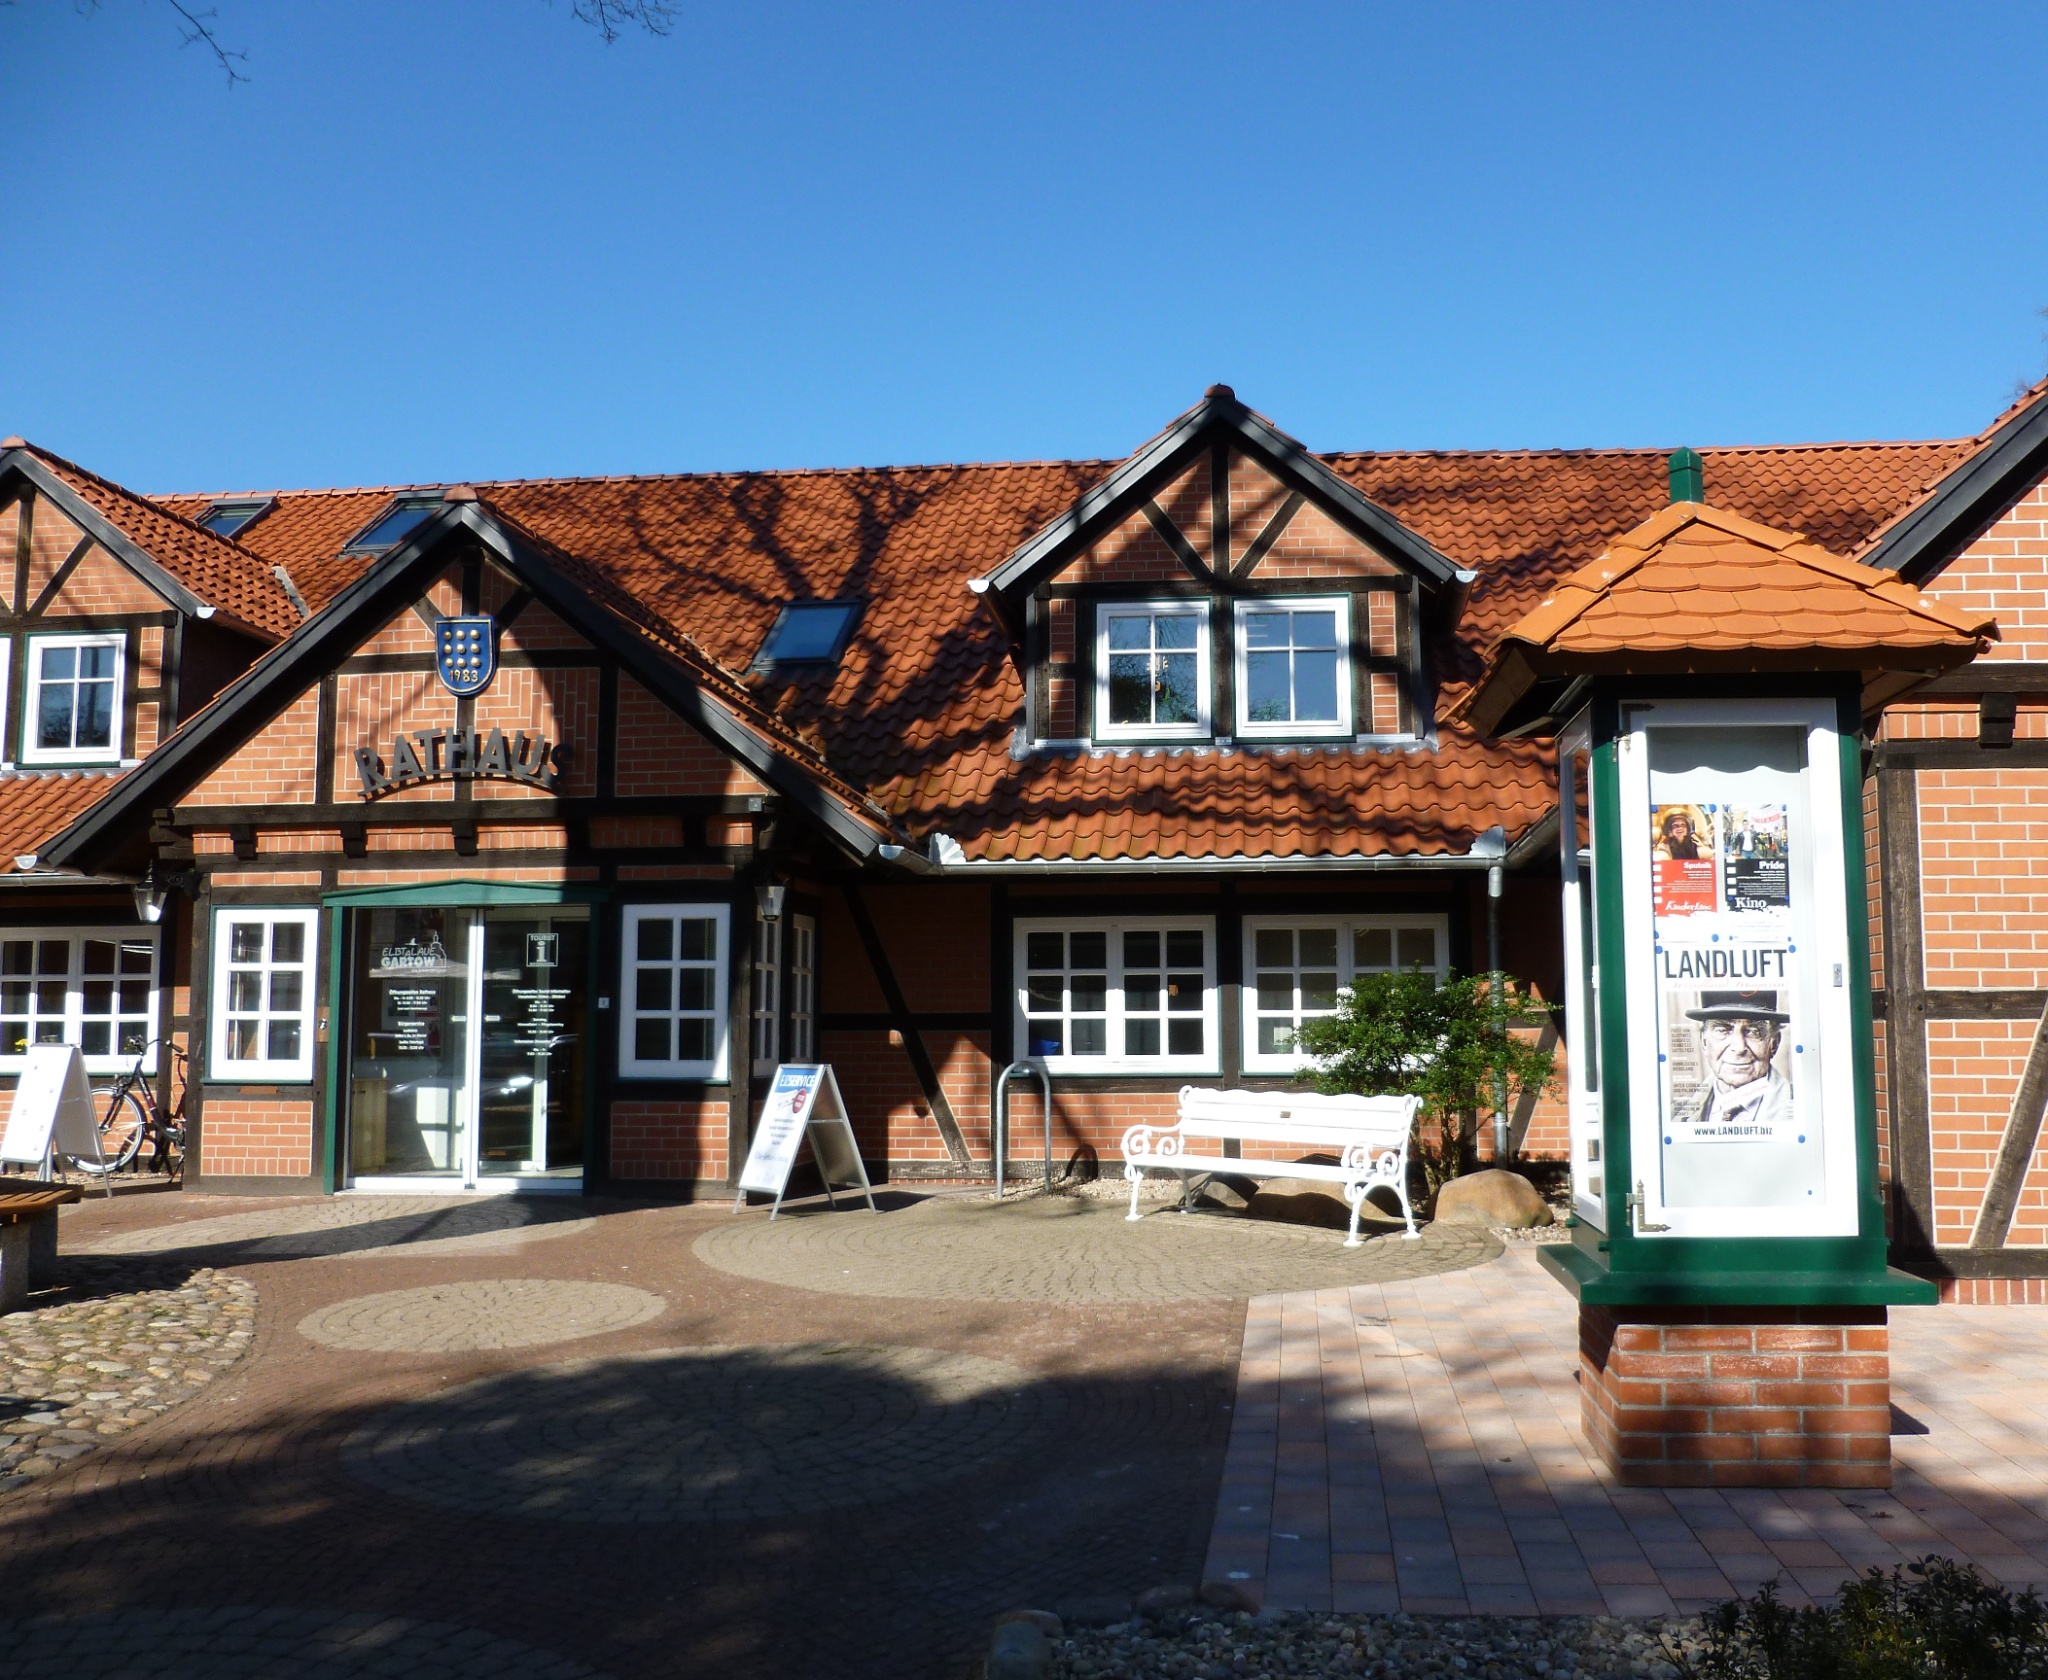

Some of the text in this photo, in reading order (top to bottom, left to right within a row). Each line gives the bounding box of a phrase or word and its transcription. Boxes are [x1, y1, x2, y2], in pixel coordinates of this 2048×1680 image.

[448, 669, 479, 683] 1983
[353, 725, 574, 794] RATHAUS
[1683, 861, 1712, 869] Sputnik
[1759, 861, 1785, 870] Pride
[1734, 896, 1767, 909] Kino
[381, 956, 436, 968] GARTOW
[1664, 949, 1788, 979] LANDLUFT
[1694, 1126, 1773, 1136] www.LANDLUFT.biz
